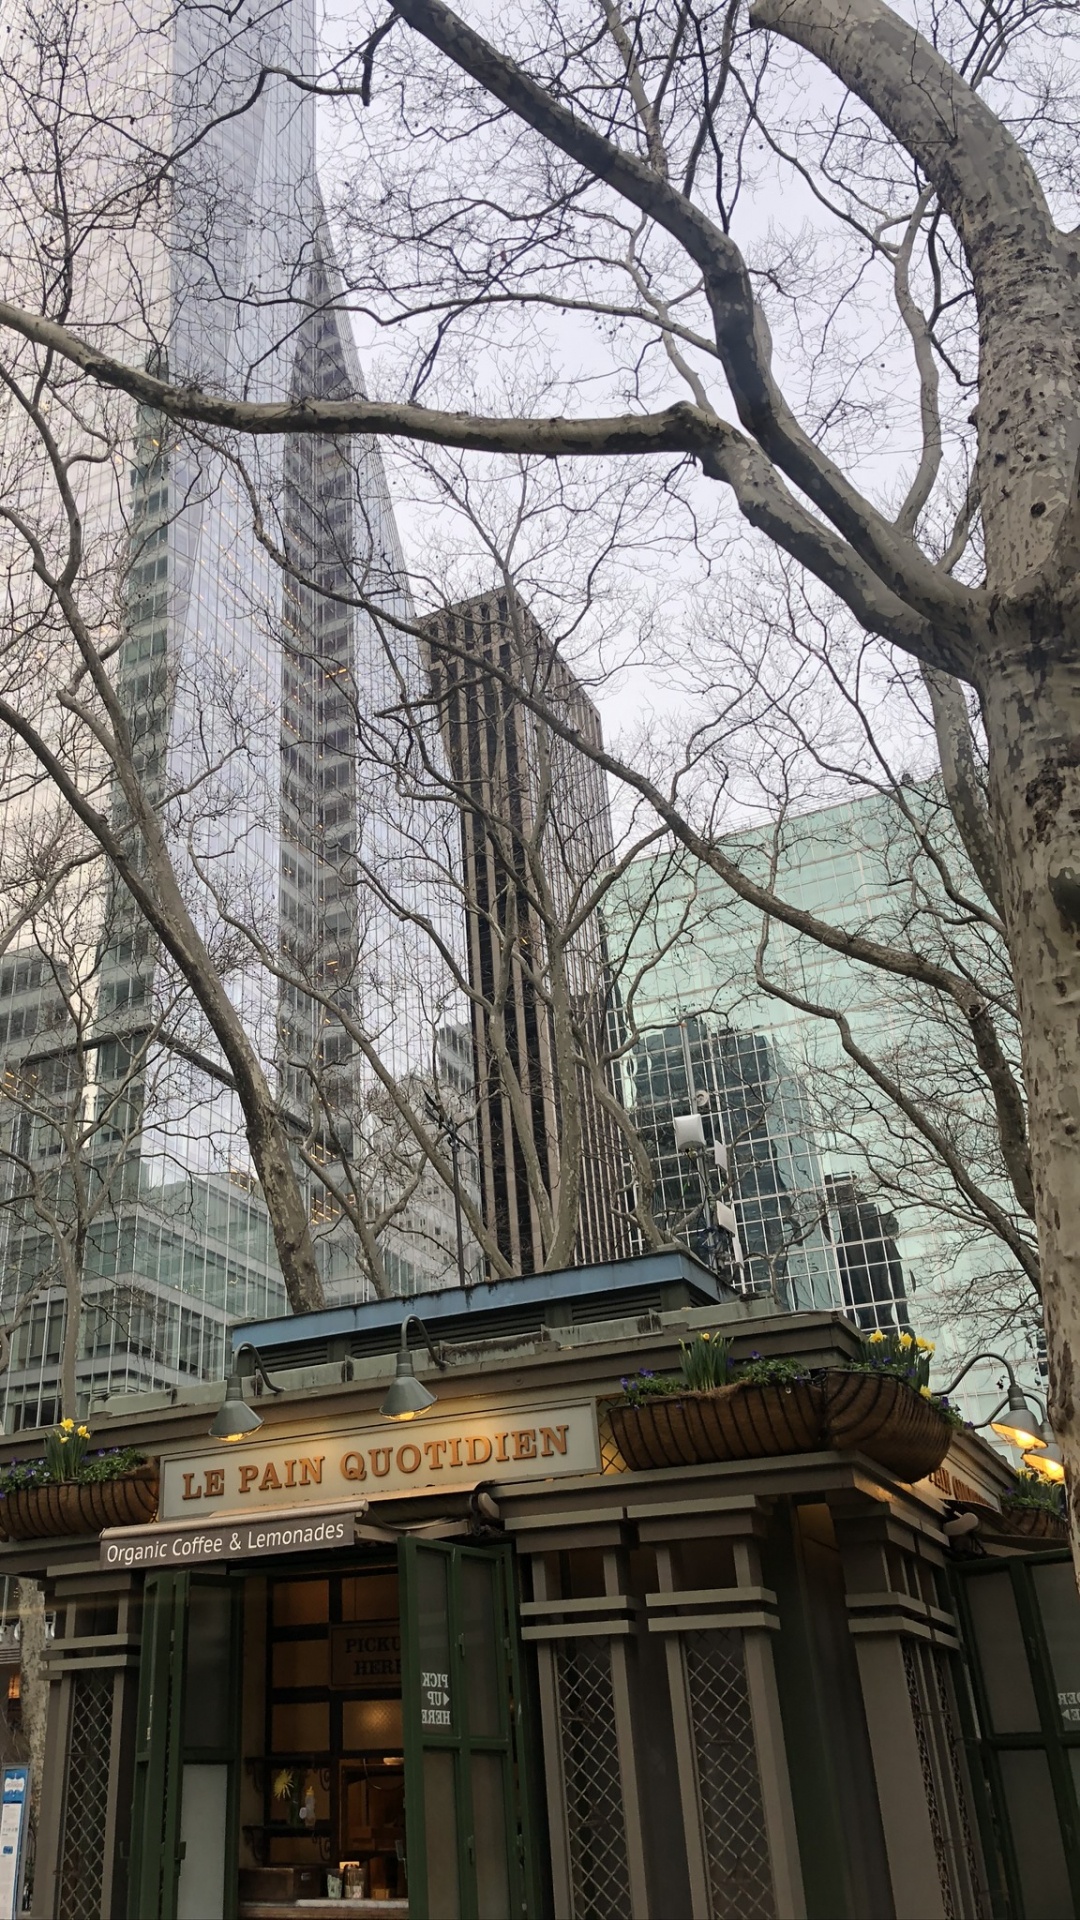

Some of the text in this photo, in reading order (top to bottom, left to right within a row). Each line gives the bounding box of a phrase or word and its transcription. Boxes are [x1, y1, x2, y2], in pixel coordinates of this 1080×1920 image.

[182, 1424, 569, 1500] LE PAIN QUOTIDIEN
[106, 1522, 344, 1565] Organic Coffee & Lemonades
[345, 1636, 400, 1653] PICKU
